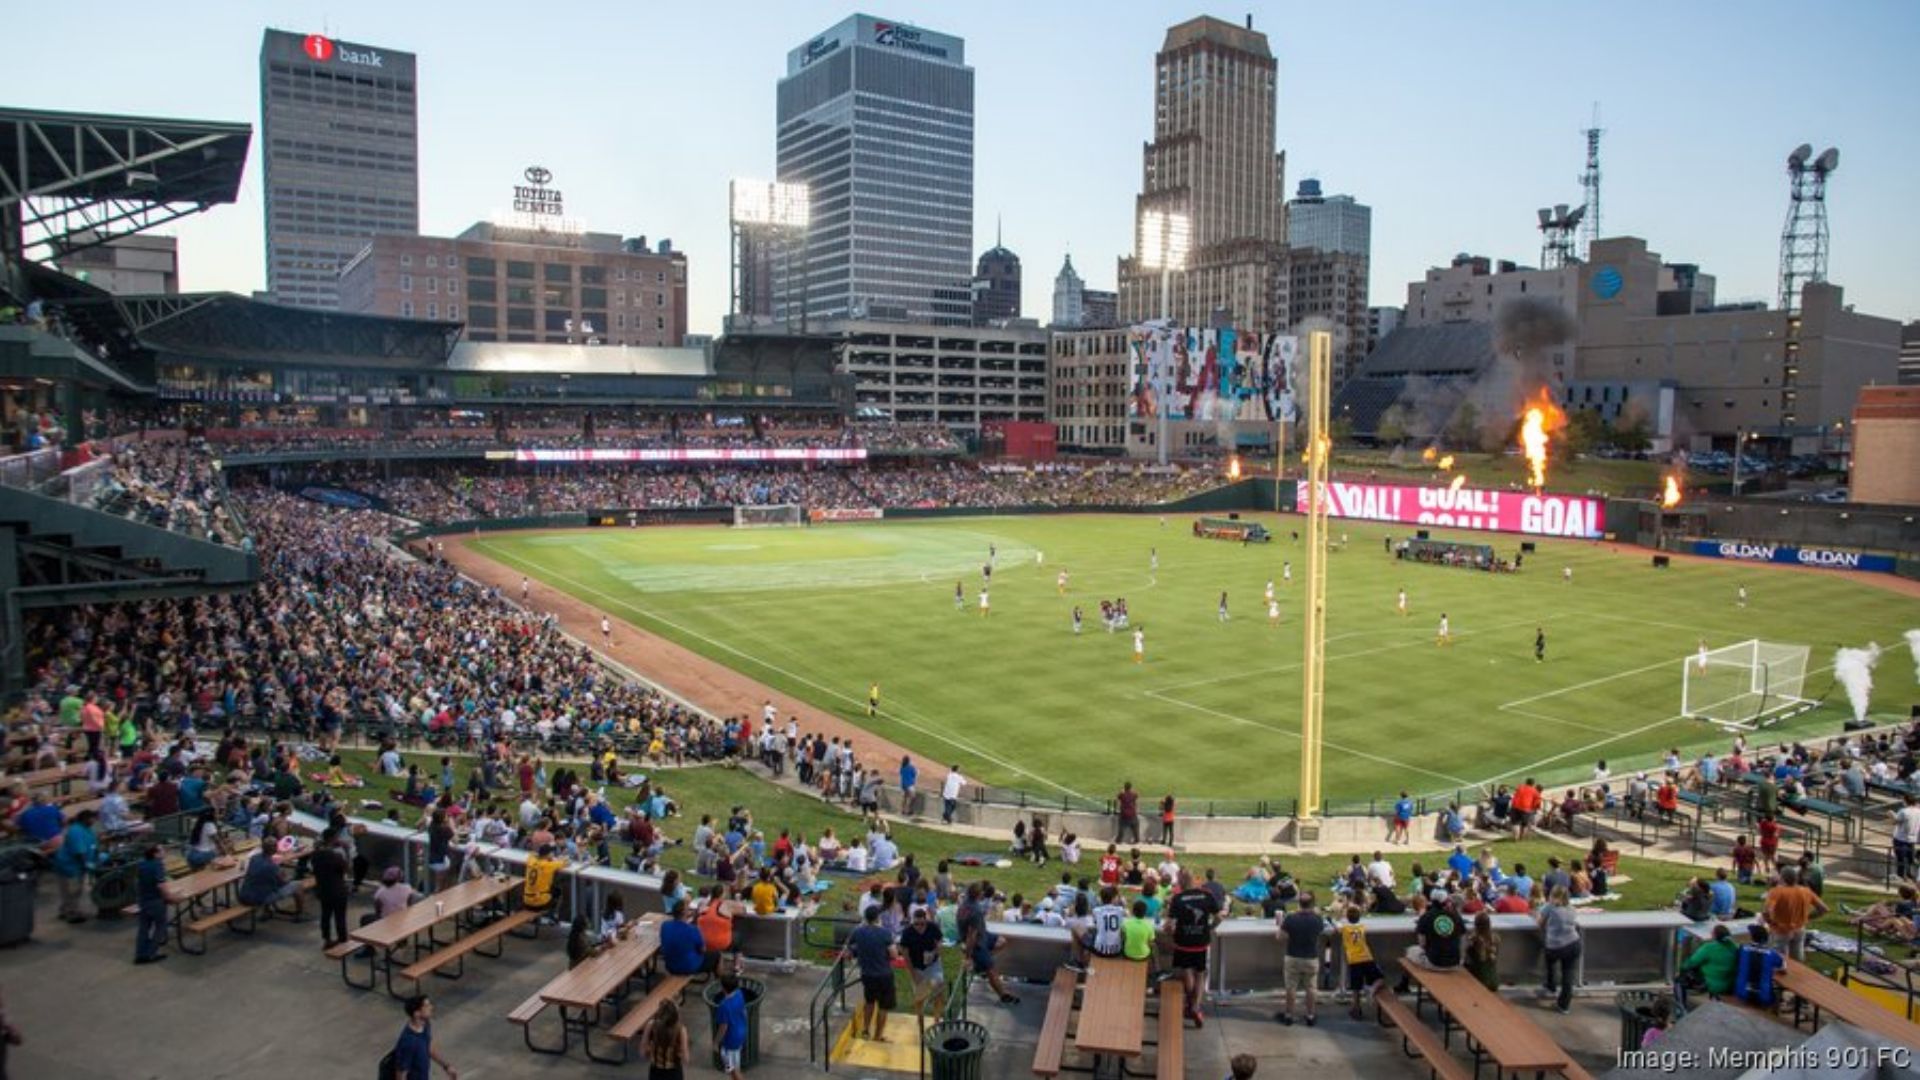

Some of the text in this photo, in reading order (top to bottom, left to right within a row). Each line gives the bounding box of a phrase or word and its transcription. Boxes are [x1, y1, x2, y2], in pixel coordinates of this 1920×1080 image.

[338, 45, 382, 68] bank
[513, 186, 562, 202] TOYOTA
[513, 199, 563, 216] CENTER
[1521, 496, 1604, 539] GOAL
[1719, 543, 1860, 566] GILDAN GILDAN
[1103, 914, 1119, 931] 10
